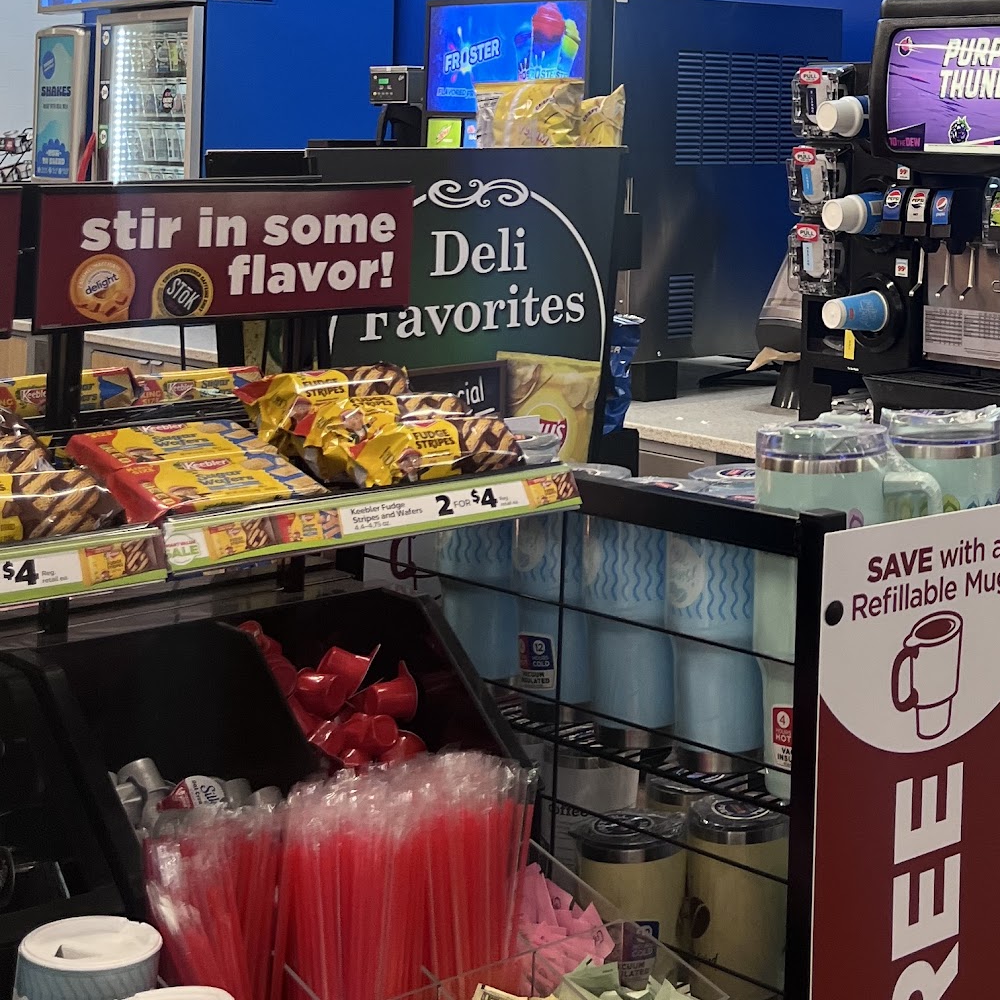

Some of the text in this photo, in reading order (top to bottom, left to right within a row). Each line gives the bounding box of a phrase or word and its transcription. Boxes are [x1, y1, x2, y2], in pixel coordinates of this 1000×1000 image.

[443, 36, 501, 74] FROSTER
[41, 86, 71, 97] SHAKES
[905, 137, 921, 147] DEW
[80, 207, 397, 252] stir in some
[430, 226, 528, 277] Deli
[227, 251, 395, 296] flavor!
[85, 272, 120, 296] delight
[359, 283, 586, 342] Favorites
[305, 386, 345, 398] STRIPES
[152, 431, 198, 443] Sugar
[413, 429, 451, 441] FUDGE
[416, 438, 456, 450] STRIPES
[184, 458, 229, 471] Keebler
[195, 469, 242, 481] Sugar
[199, 476, 254, 487] Wafers
[350, 501, 406, 515] Keebler Fudge
[434, 487, 499, 517] 2 FOR $4
[352, 507, 423, 525] Stripes and Wafers
[866, 545, 934, 584] SAVE
[940, 539, 986, 571] with
[2, 559, 40, 586] $4
[851, 578, 958, 622] Refillable
[779, 714, 786, 726] 4
[775, 734, 792, 743] HOT
